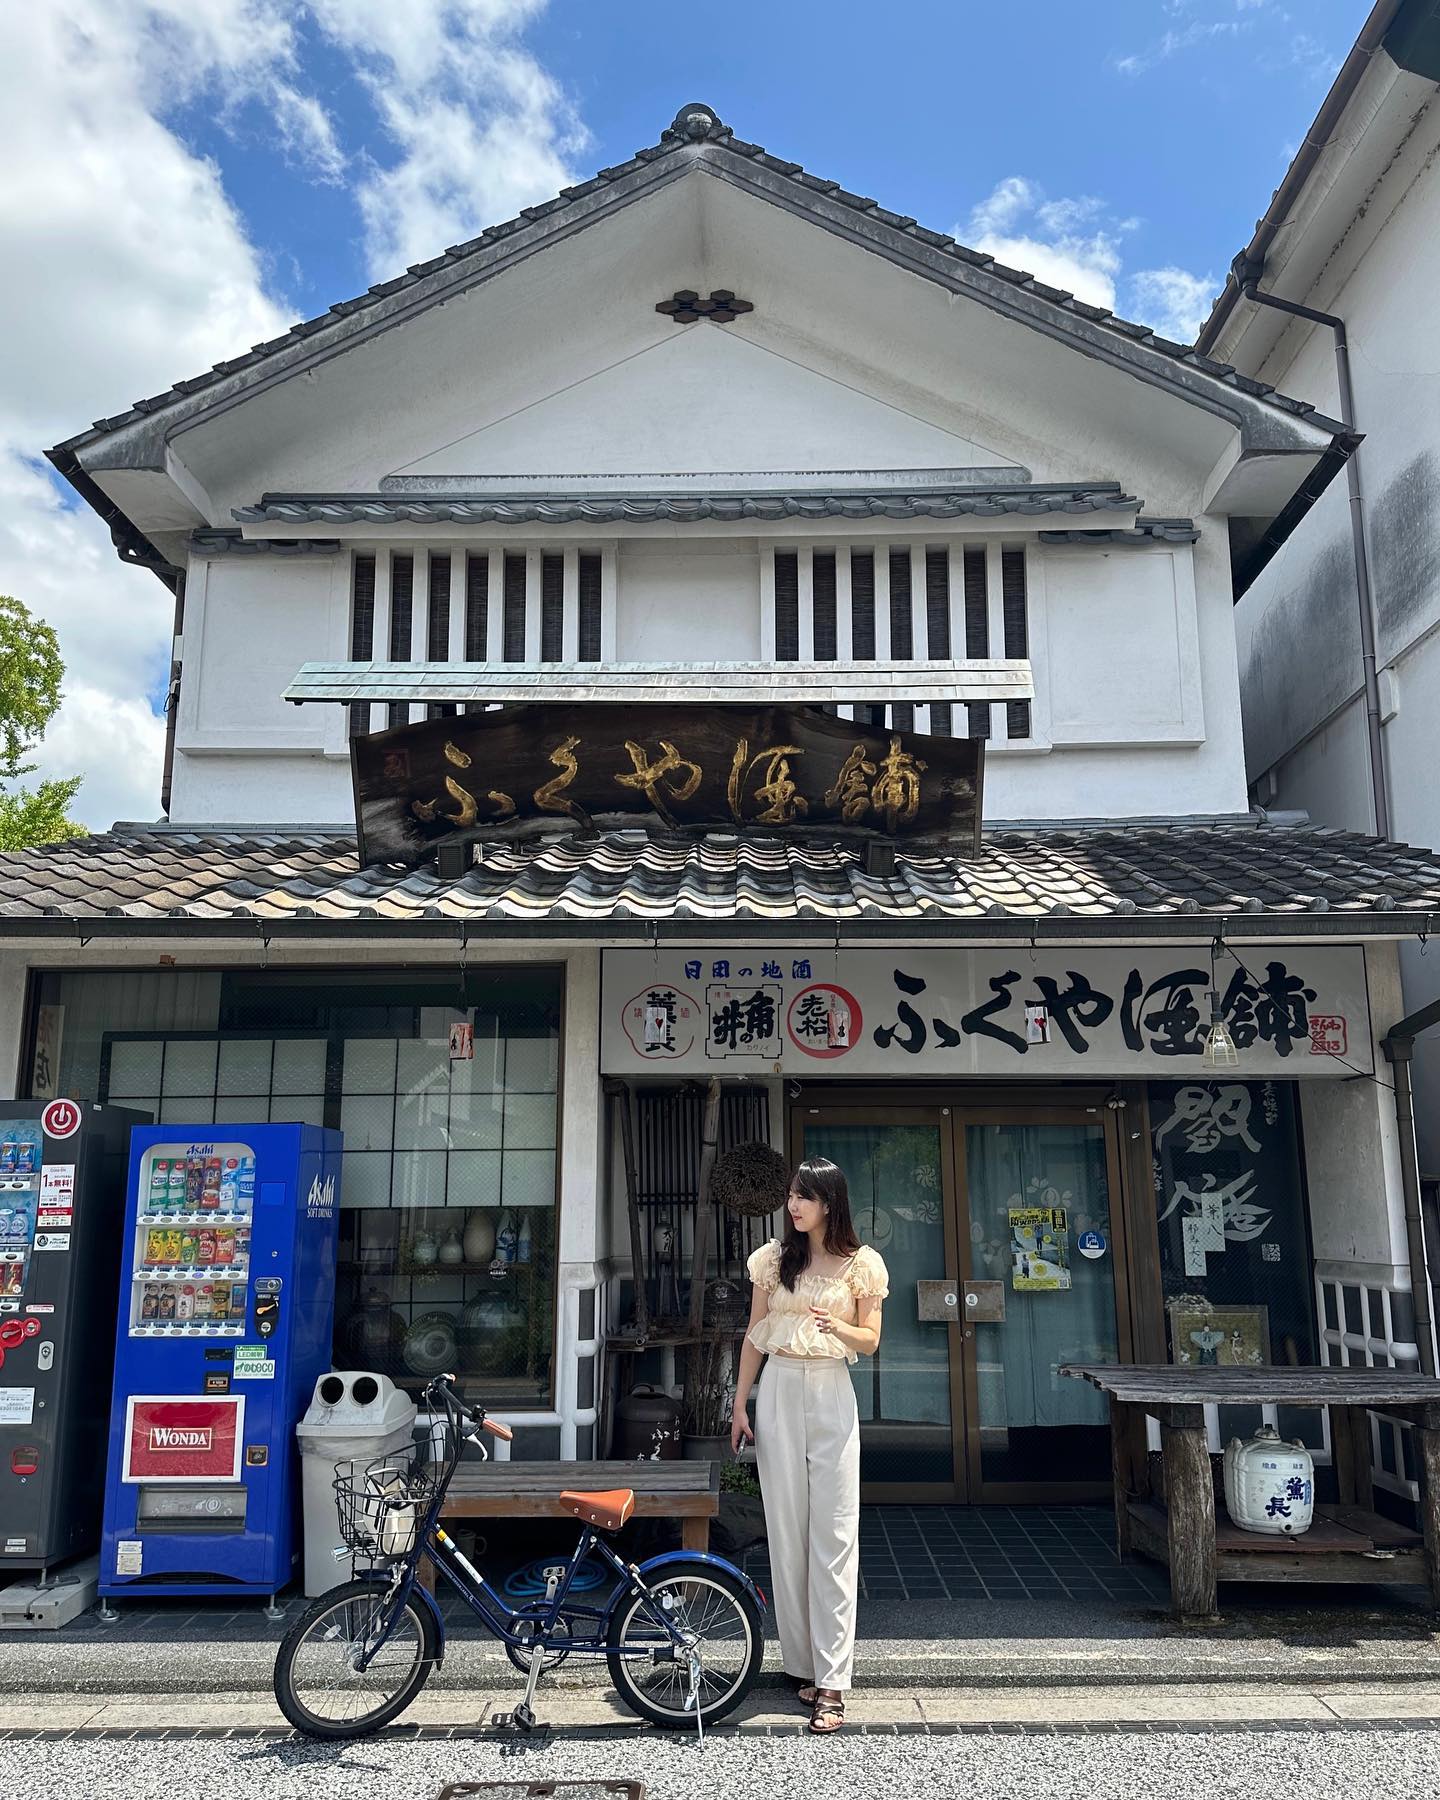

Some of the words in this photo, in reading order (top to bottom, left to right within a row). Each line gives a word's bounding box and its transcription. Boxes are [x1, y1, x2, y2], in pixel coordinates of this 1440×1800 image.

[685, 959, 812, 980] 日田の地酒
[1311, 1030, 1326, 1040] 22
[186, 1144, 214, 1156] Asahi
[307, 1173, 336, 1207] Asahi
[307, 1208, 318, 1218] SOFT
[318, 1208, 333, 1218] DRINKS
[153, 1427, 207, 1447] WONDA
